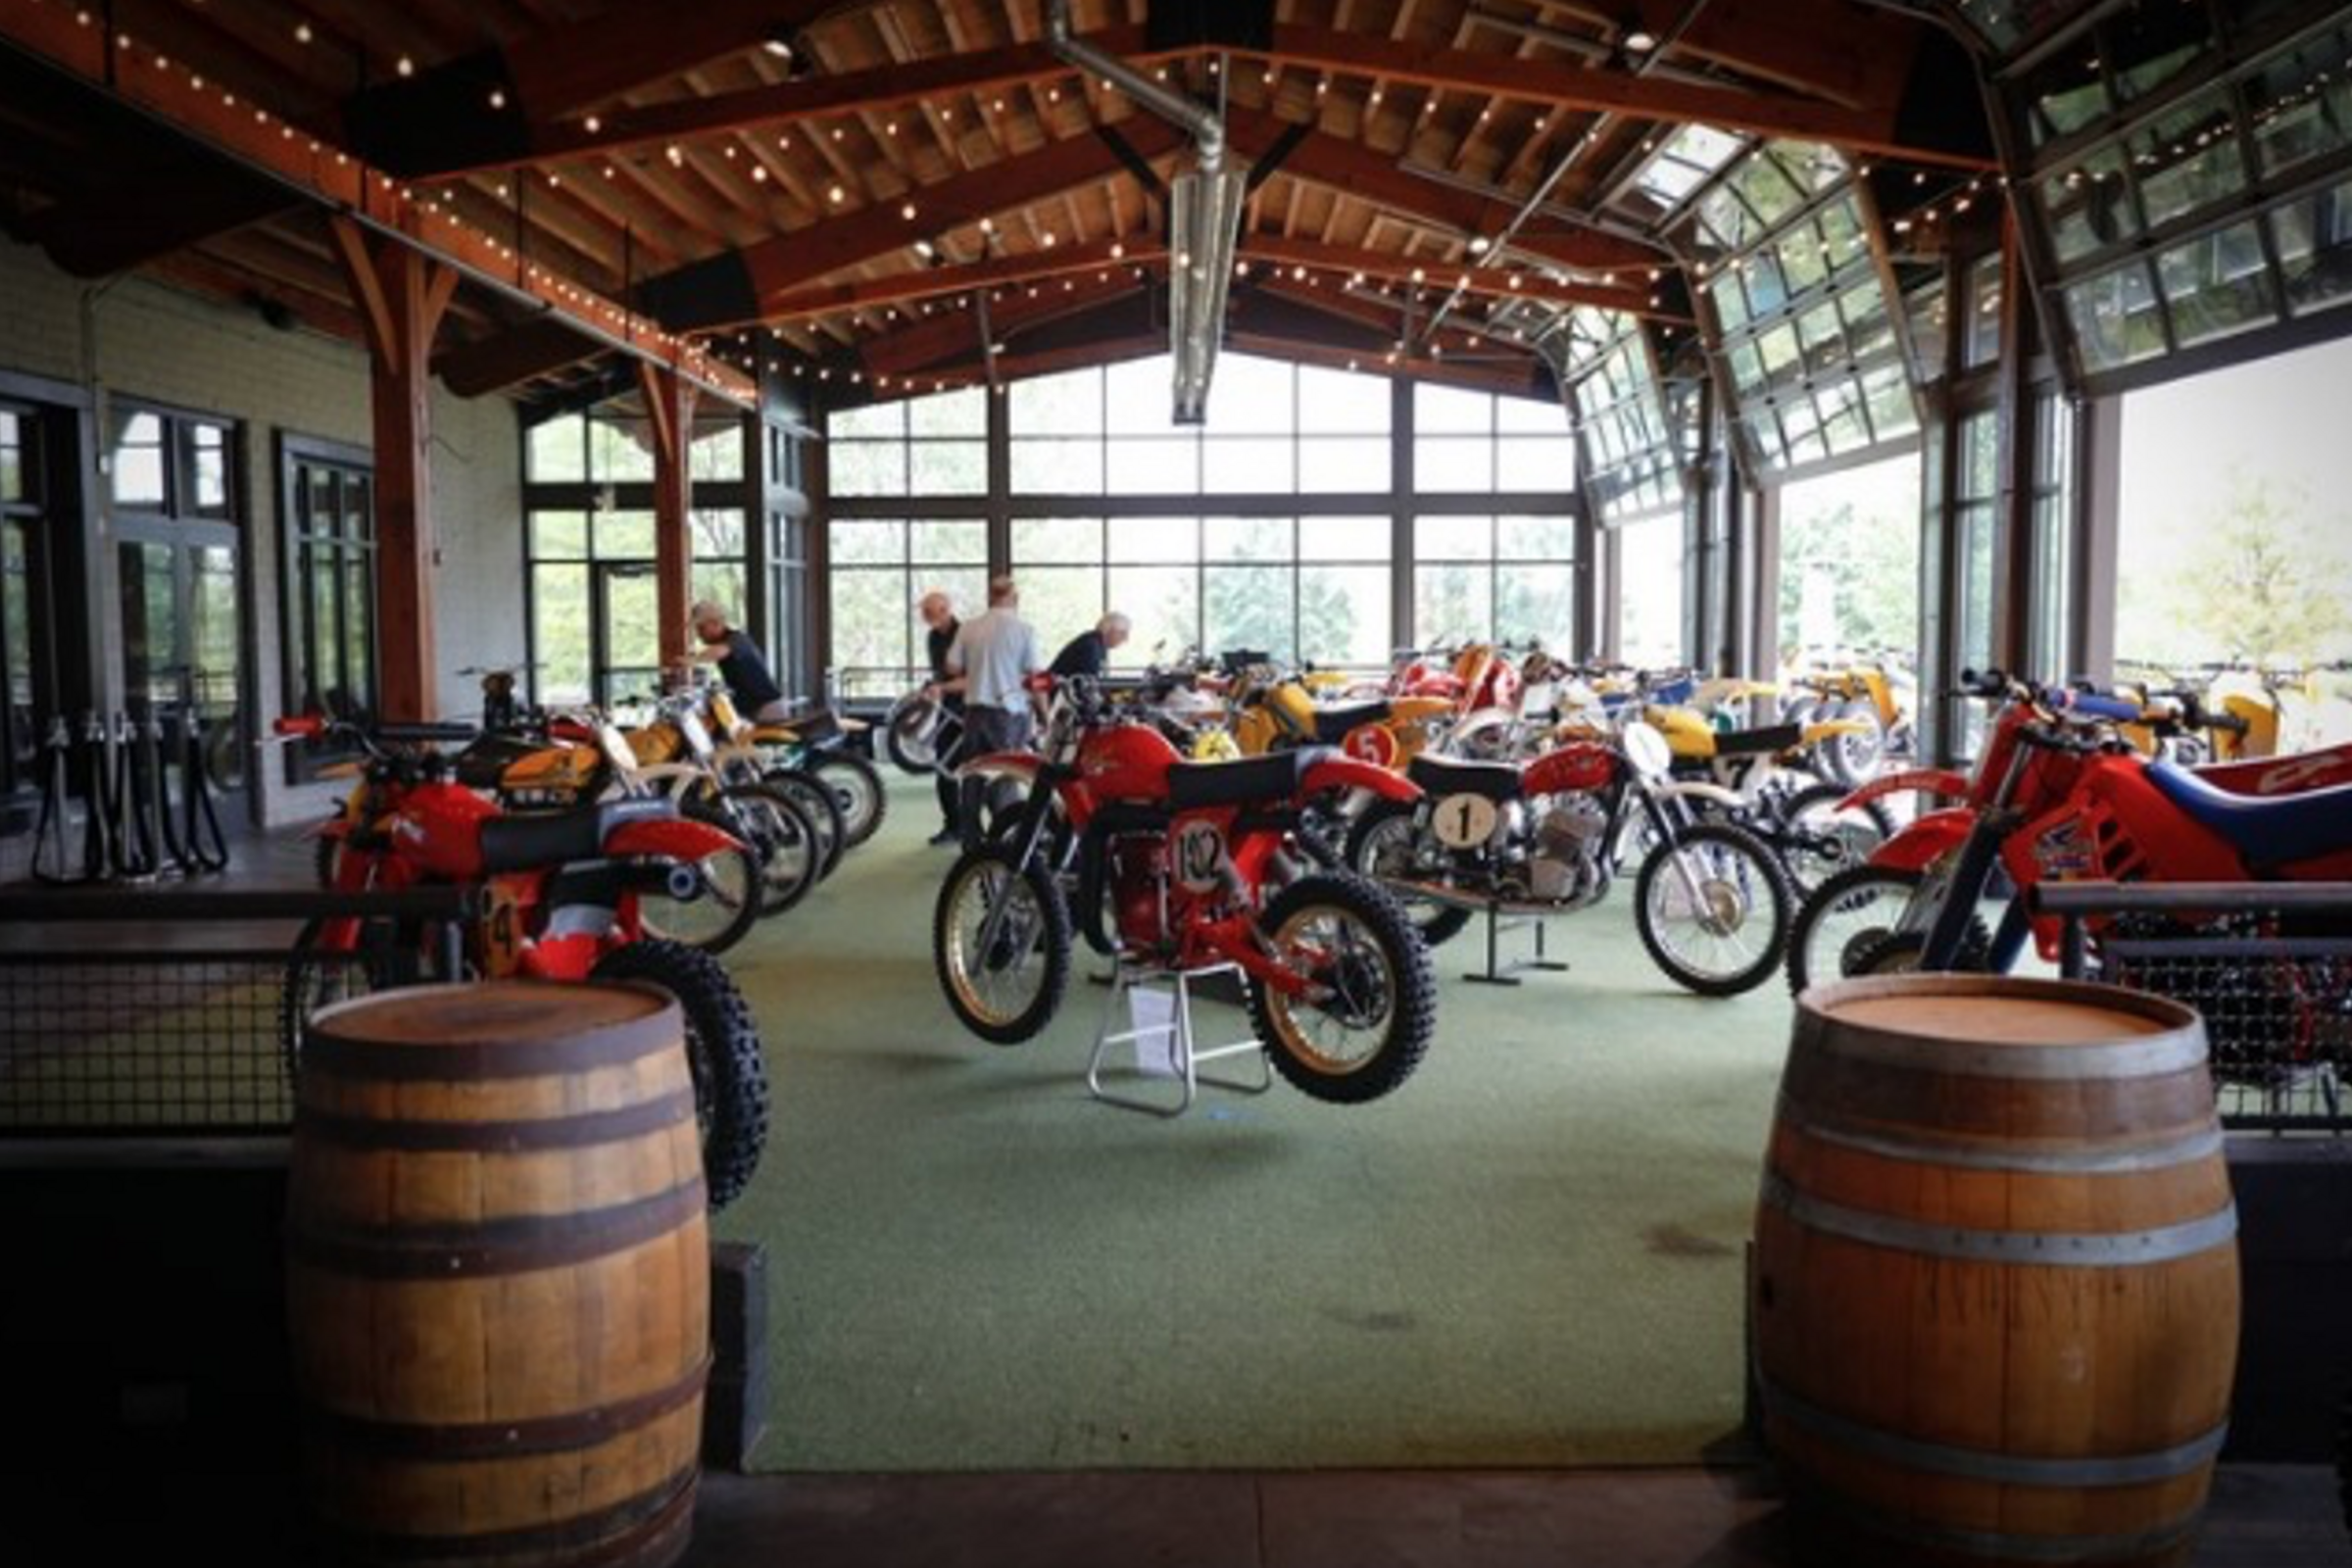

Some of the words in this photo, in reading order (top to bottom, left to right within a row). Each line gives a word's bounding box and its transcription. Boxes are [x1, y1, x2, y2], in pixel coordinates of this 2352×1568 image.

[1357, 730, 1381, 764] 5
[1726, 756, 1755, 792] 7
[1457, 800, 1471, 842] 1
